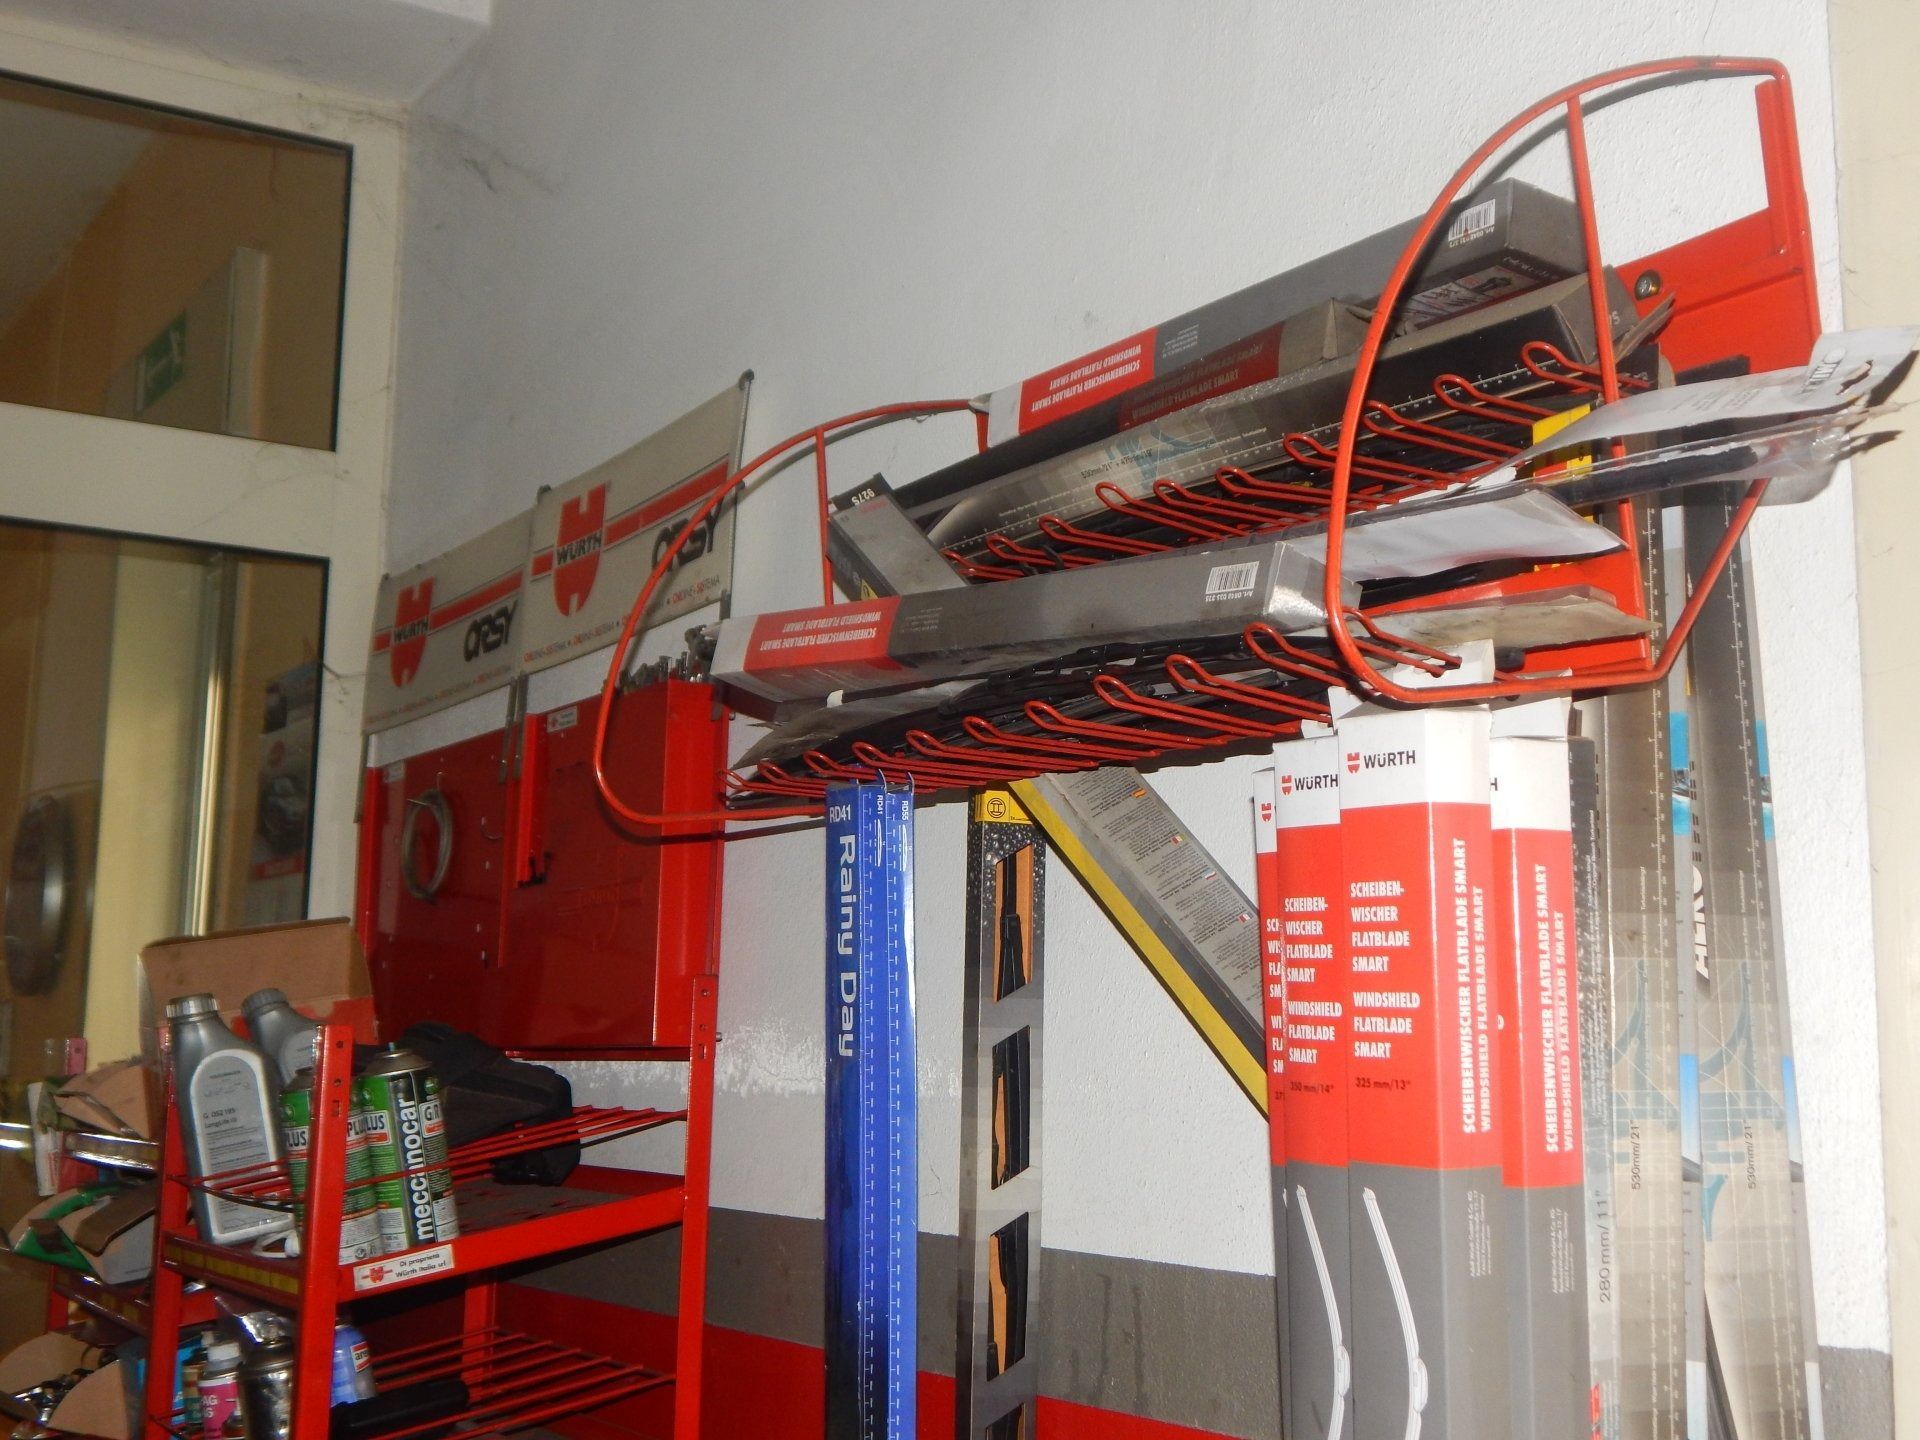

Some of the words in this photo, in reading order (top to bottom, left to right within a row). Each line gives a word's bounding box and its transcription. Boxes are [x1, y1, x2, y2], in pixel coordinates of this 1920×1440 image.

[1363, 750, 1416, 769] WÜRTH
[1294, 773, 1339, 791] WÜRTH
[829, 804, 851, 823] RD41
[901, 800, 909, 821] RD55
[1453, 837, 1467, 894] SMART
[838, 834, 856, 956] Rainy
[1350, 880, 1404, 898] SCHEIBEN-
[1535, 864, 1549, 918] SMART
[1284, 897, 1328, 912] SCHEIBEN-
[1351, 906, 1398, 922] WISCHER
[1473, 886, 1485, 942] SMART
[1286, 920, 1323, 935] WISCHER
[1352, 931, 1410, 948] FLATBLADE
[1455, 897, 1470, 983] FLATBLADE
[1554, 911, 1566, 965] SMART
[1286, 944, 1333, 959] FLATBLADE
[1352, 956, 1389, 972] SMART
[1538, 921, 1553, 1005] FLATBLADE
[1287, 968, 1316, 982] SMART
[1475, 945, 1488, 1030] FLATBLADE
[1288, 1001, 1343, 1017] WINDSHIELD
[1353, 992, 1420, 1008] WINDSHIELD
[1557, 967, 1569, 1051] FLATBLADE
[838, 972, 857, 1057] Day
[1288, 1024, 1335, 1041] FLATBLADE
[1354, 1016, 1412, 1034] FLATBLADE
[1289, 1047, 1317, 1064] SMART
[1354, 1042, 1391, 1058] SMART
[1458, 986, 1476, 1133] SCHEIBENWISCHER
[1478, 1033, 1491, 1132] WINDSHIELD
[1541, 1008, 1559, 1152] SCHEIBENWISCHER
[1560, 1055, 1574, 1152] WINDSHIELD
[347, 1119, 366, 1138] PLU
[366, 1114, 385, 1131] LUS
